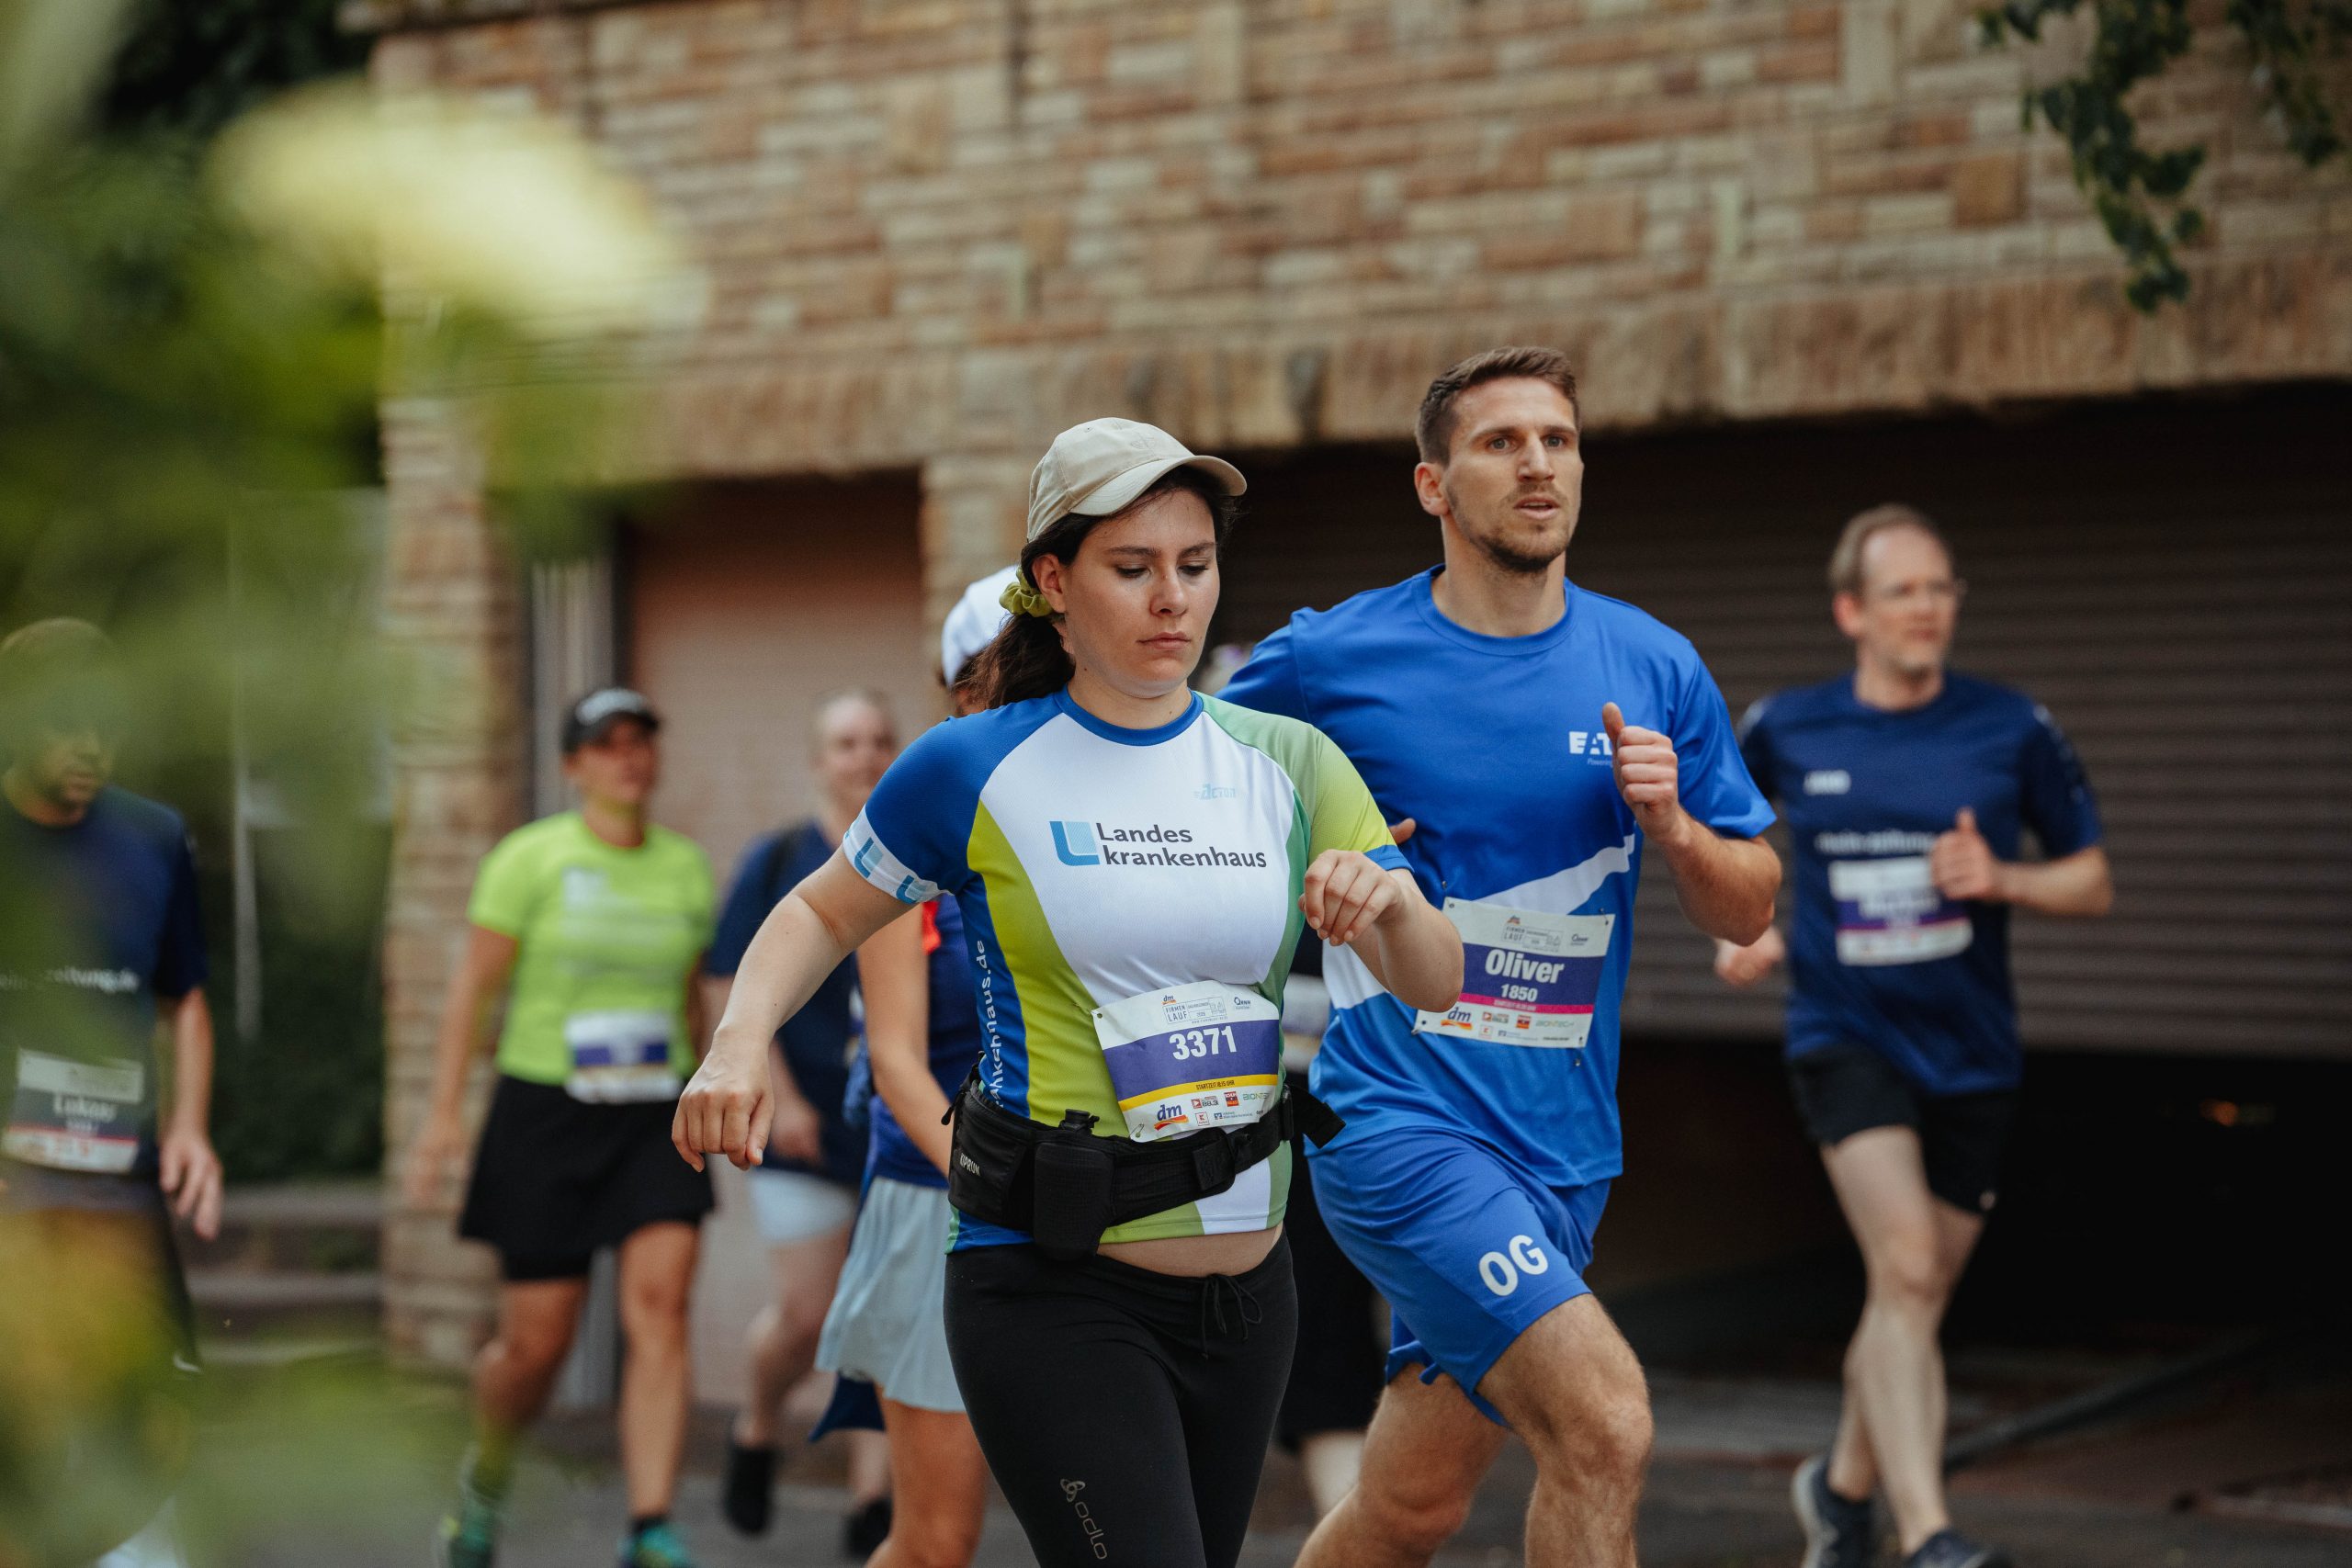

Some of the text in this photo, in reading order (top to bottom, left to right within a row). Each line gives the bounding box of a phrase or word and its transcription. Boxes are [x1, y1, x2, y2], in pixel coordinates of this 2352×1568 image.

[1569, 731, 1613, 755] EAT
[1096, 822, 1193, 843] Landes
[1102, 844, 1266, 868] krankenhaus
[1485, 949, 1565, 984] Oliver
[1500, 983, 1538, 1002] 1850
[1447, 1007, 1472, 1022] dm
[1169, 1025, 1237, 1061] 3371
[1157, 1104, 1182, 1122] dm
[1478, 1234, 1549, 1297] OG
[1074, 1501, 1108, 1560] odlo
